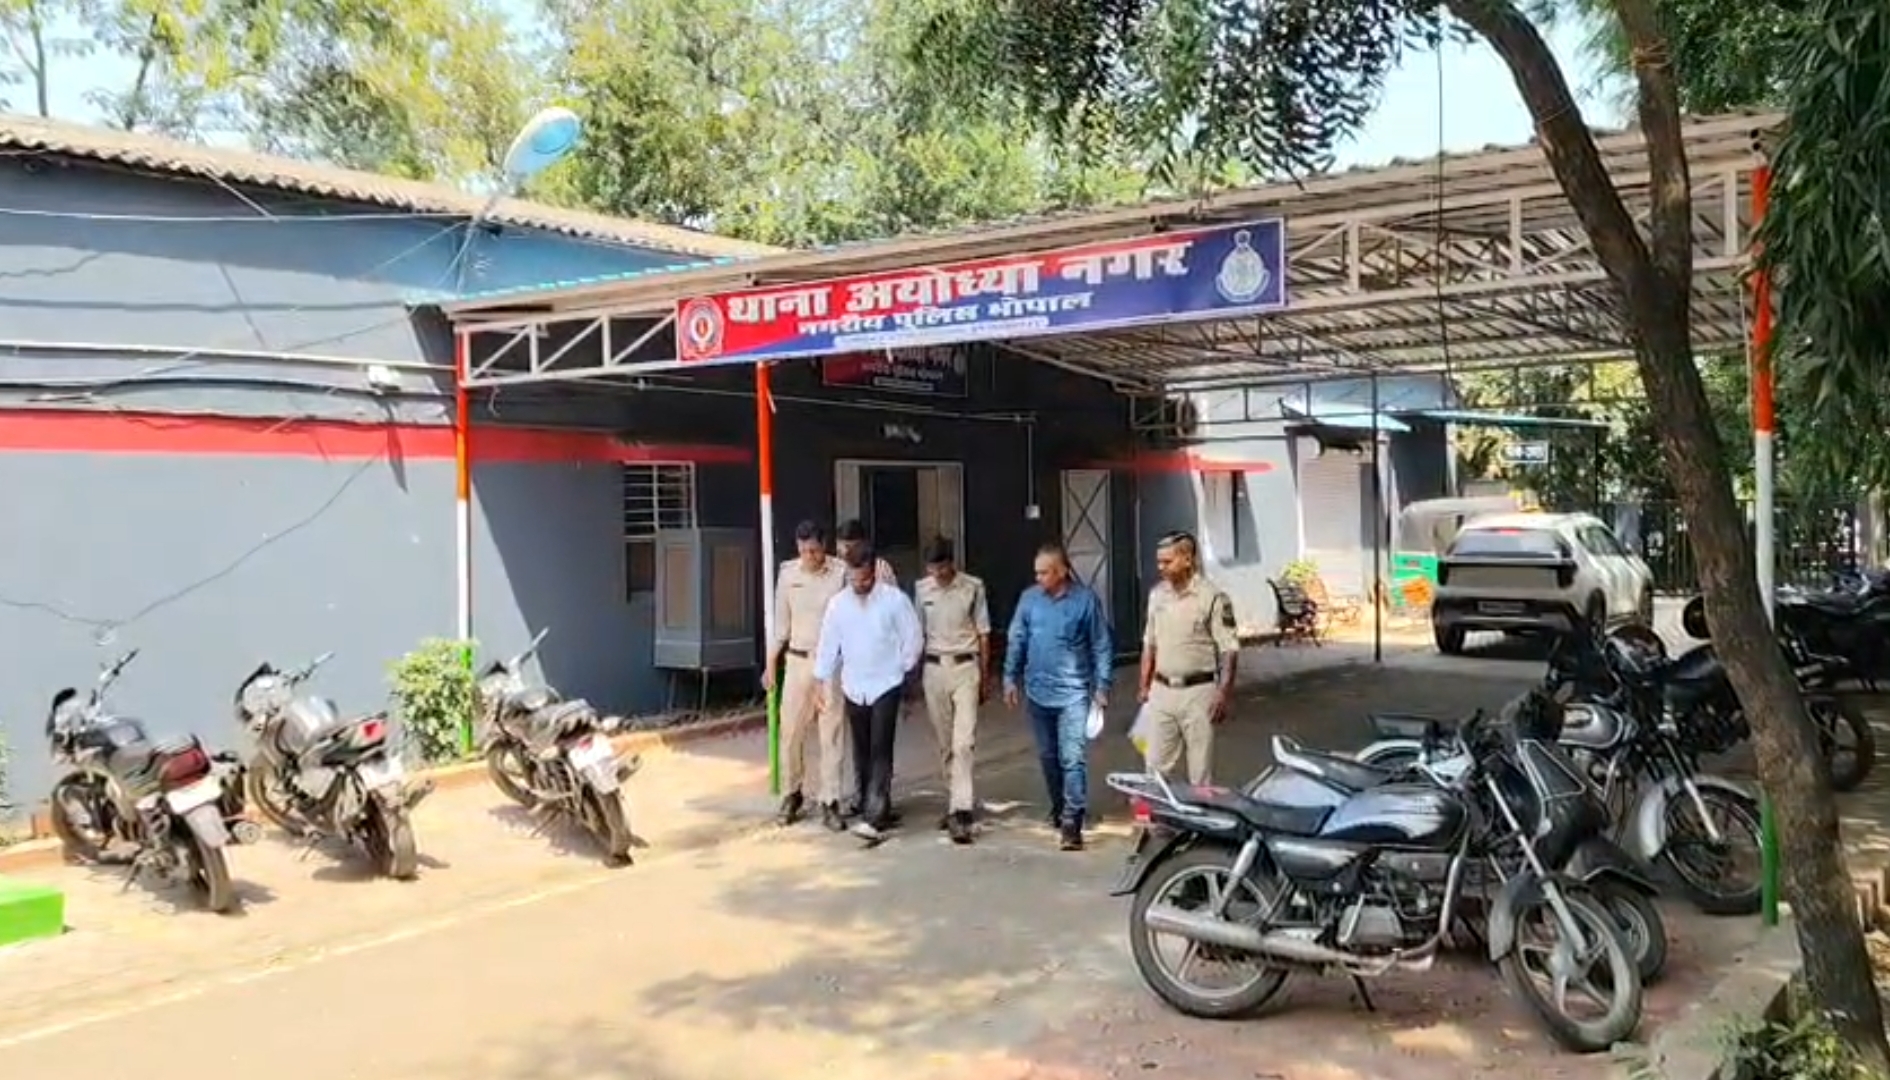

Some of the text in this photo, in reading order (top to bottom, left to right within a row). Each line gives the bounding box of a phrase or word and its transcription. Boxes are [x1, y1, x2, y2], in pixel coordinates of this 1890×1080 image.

[727, 241, 1193, 323] थाना अयोध्या नगर
[797, 313, 885, 335] नगरीय
[896, 302, 978, 329] पुलिस
[989, 292, 1094, 315] भोपाल
